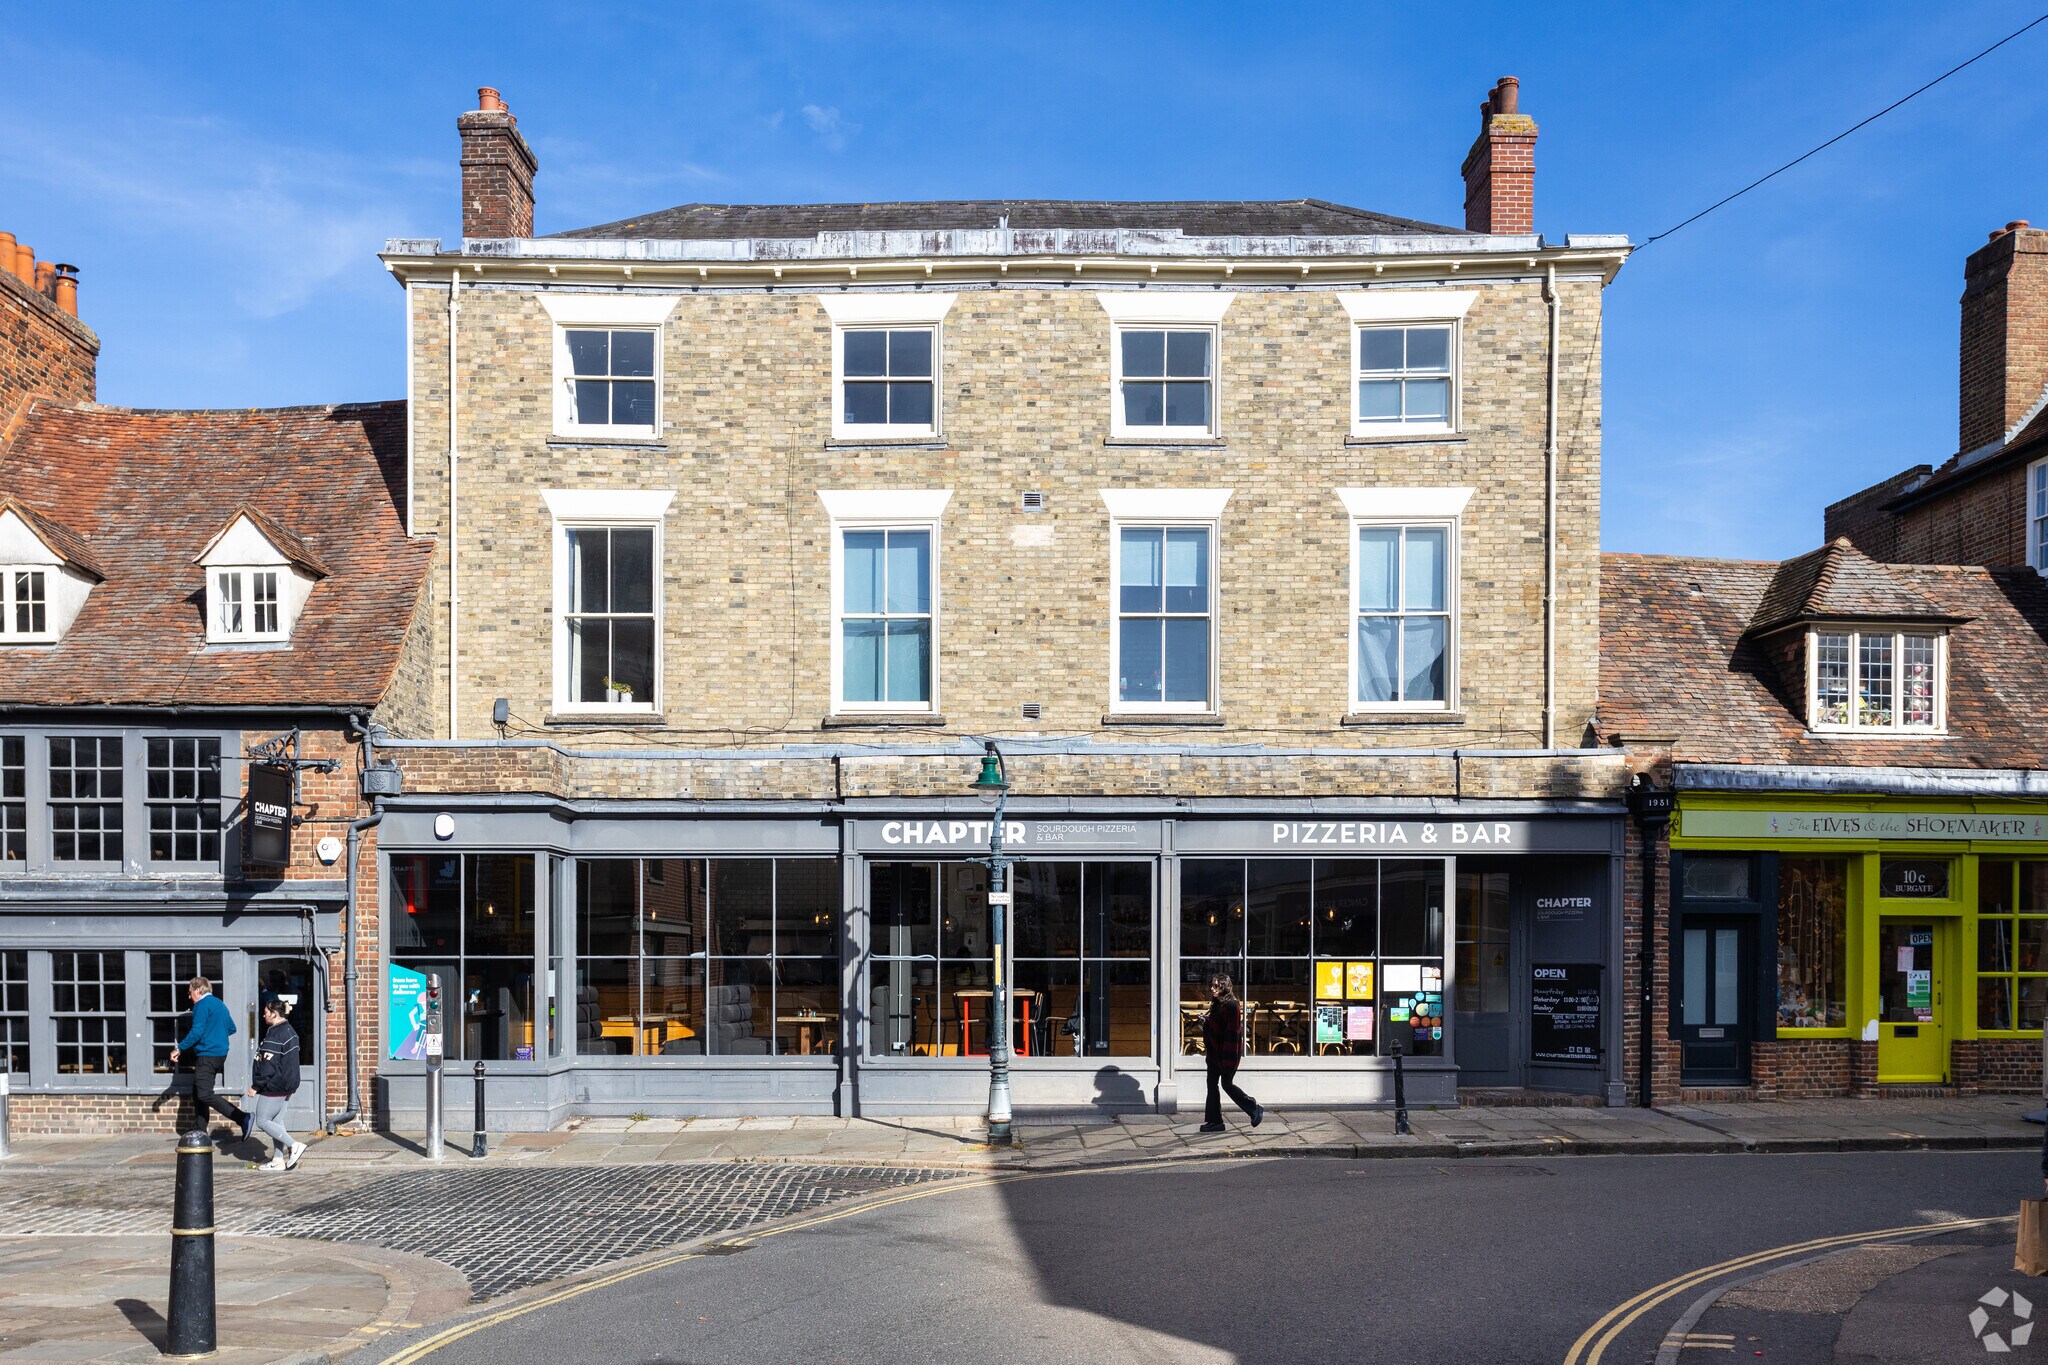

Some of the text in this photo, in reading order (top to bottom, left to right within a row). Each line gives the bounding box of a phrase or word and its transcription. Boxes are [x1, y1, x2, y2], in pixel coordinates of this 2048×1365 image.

[255, 802, 287, 817] CHAPTER
[1036, 825, 1137, 833] SOURDOUGH PIZZERIA
[1788, 817, 2025, 836] The ELVES & the SHOEMAKER
[881, 822, 1026, 844] CHAPTER
[1273, 823, 1511, 844] PIZZERIA & BAR
[1536, 897, 1592, 908] CHAPTER
[1913, 935, 1932, 943] OPEN
[1534, 968, 1566, 978] OPEN
[1533, 996, 1560, 1004] Saturday
[1533, 1004, 1554, 1012] Sunday
